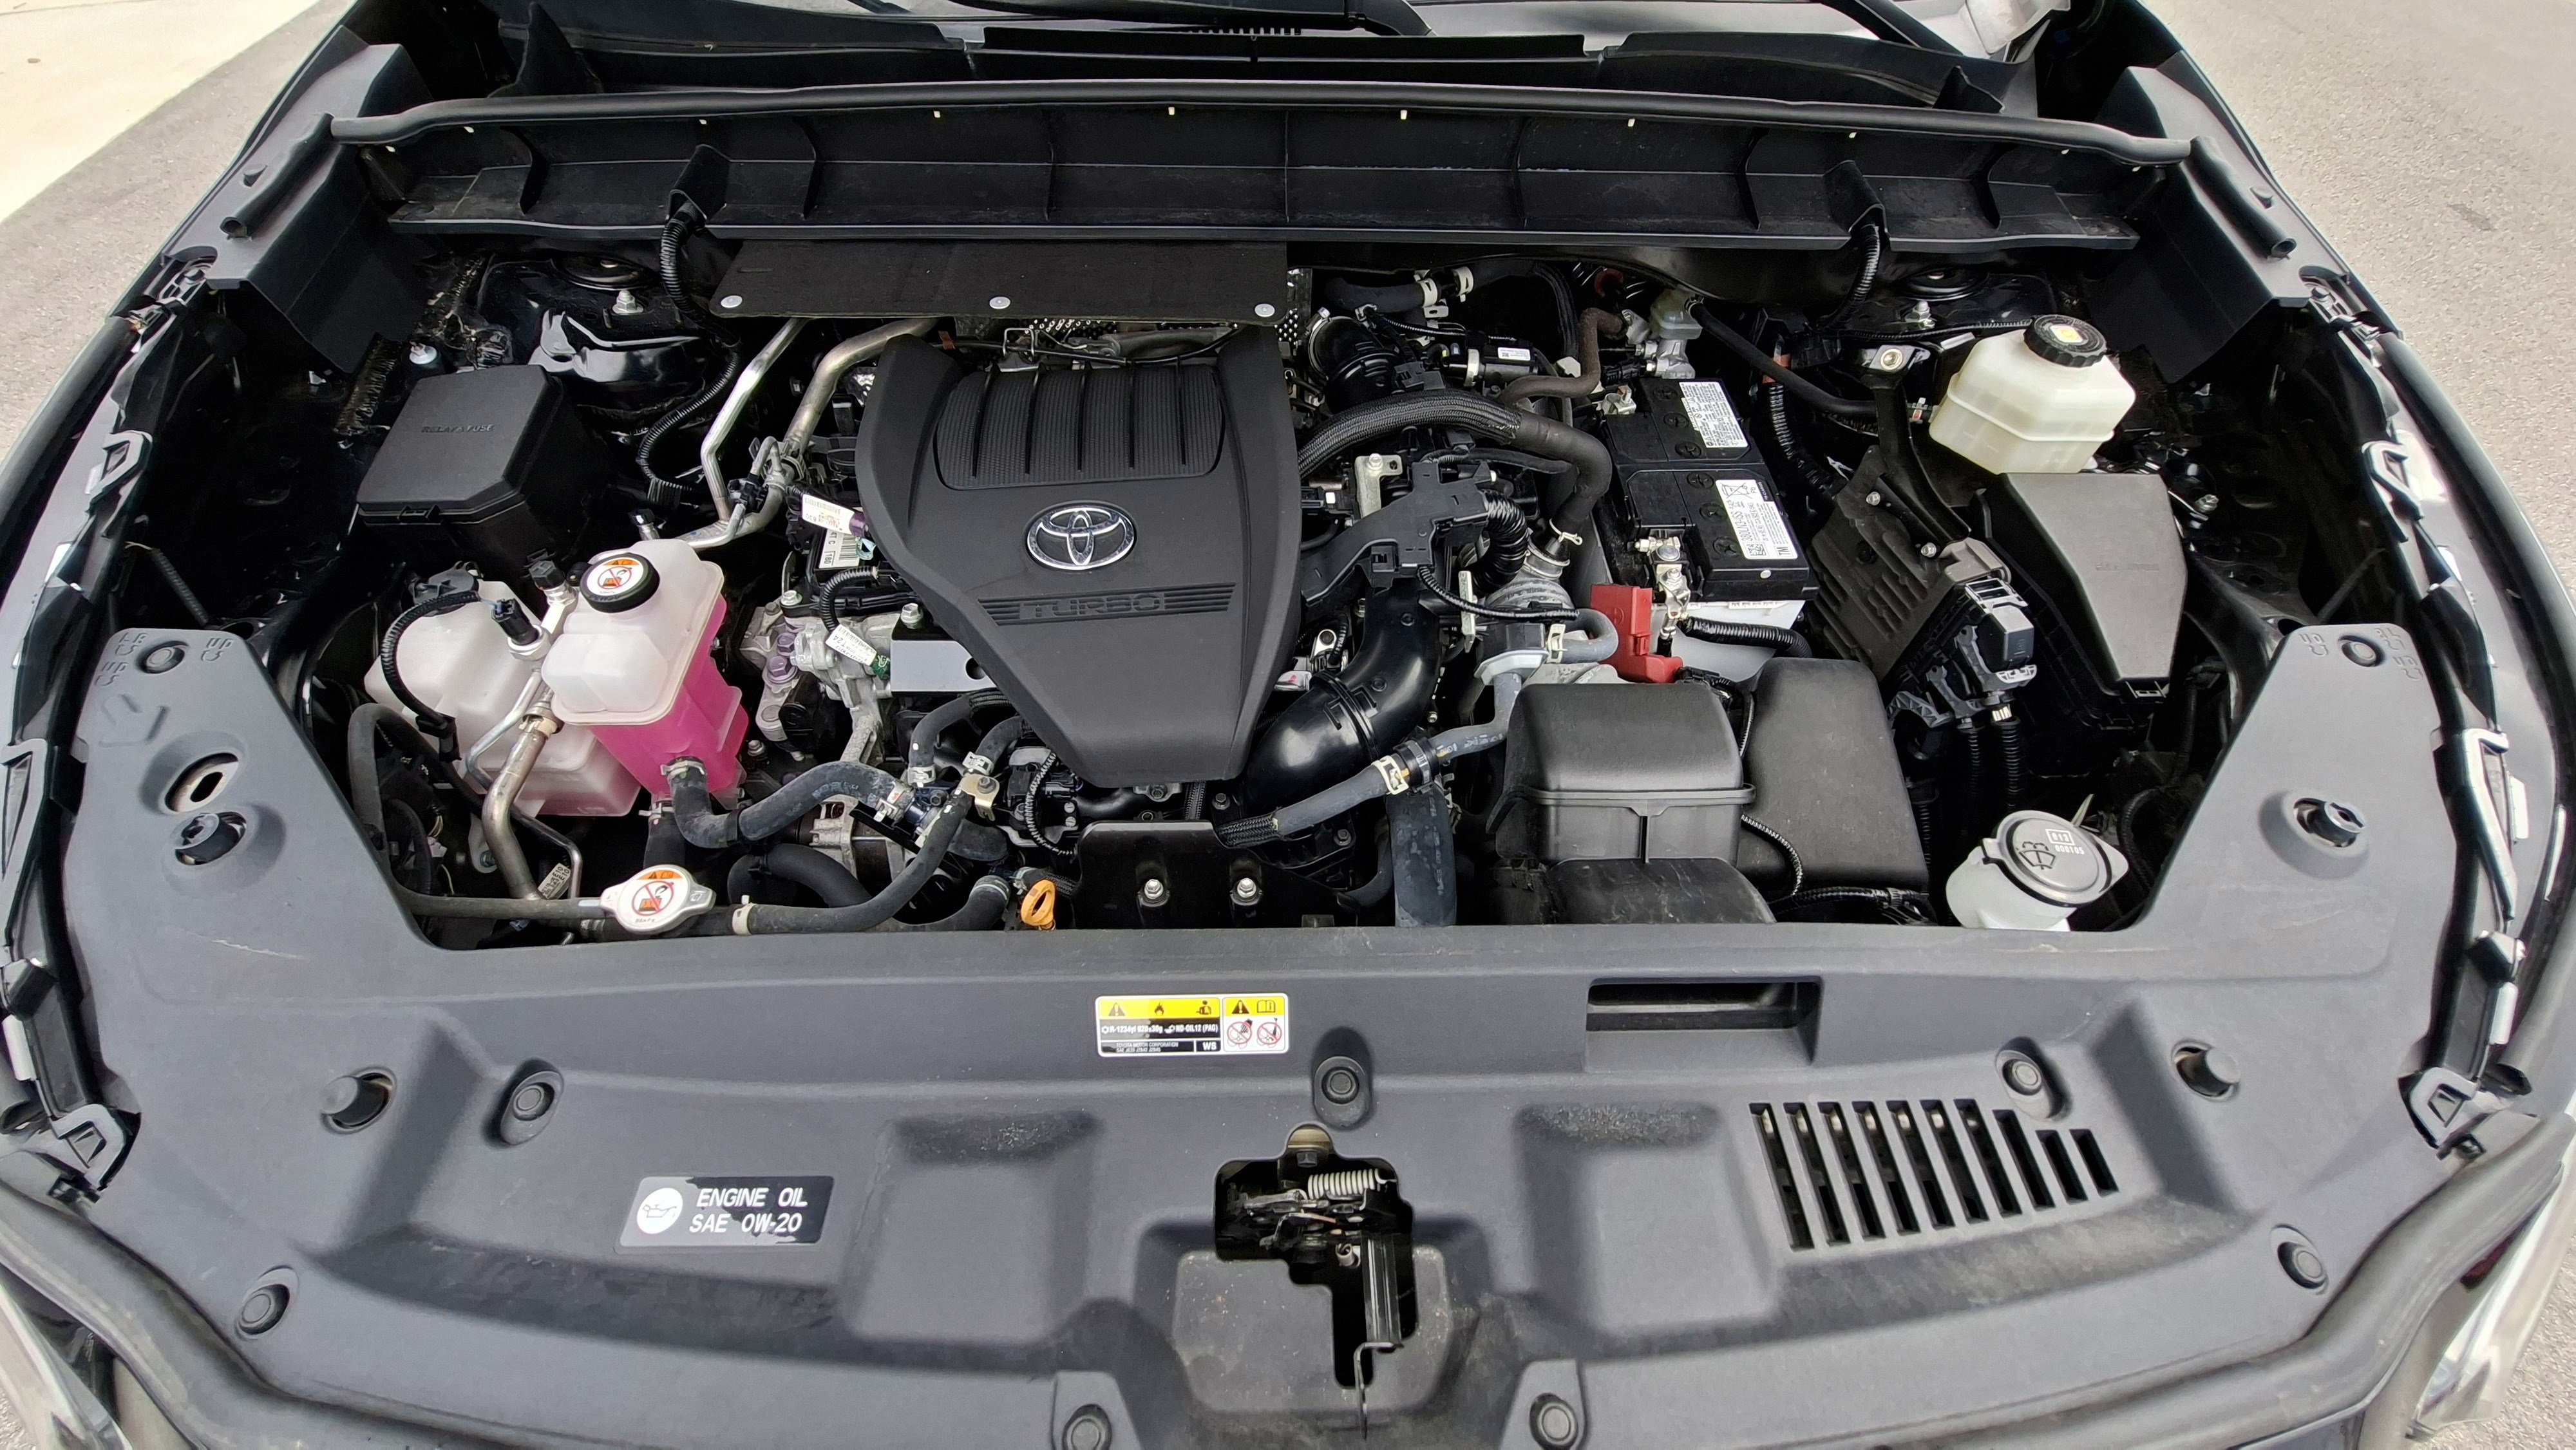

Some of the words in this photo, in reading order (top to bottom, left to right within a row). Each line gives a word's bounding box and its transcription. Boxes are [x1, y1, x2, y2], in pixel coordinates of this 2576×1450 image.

[1023, 593, 1160, 618] TURBO
[2054, 844, 2085, 855] 000105
[1202, 1024, 1218, 1033] (PAG)
[696, 1187, 770, 1208] ENGINE
[778, 1187, 808, 1208] OIL
[689, 1213, 732, 1233] SAE
[741, 1212, 803, 1233] 0W-20
